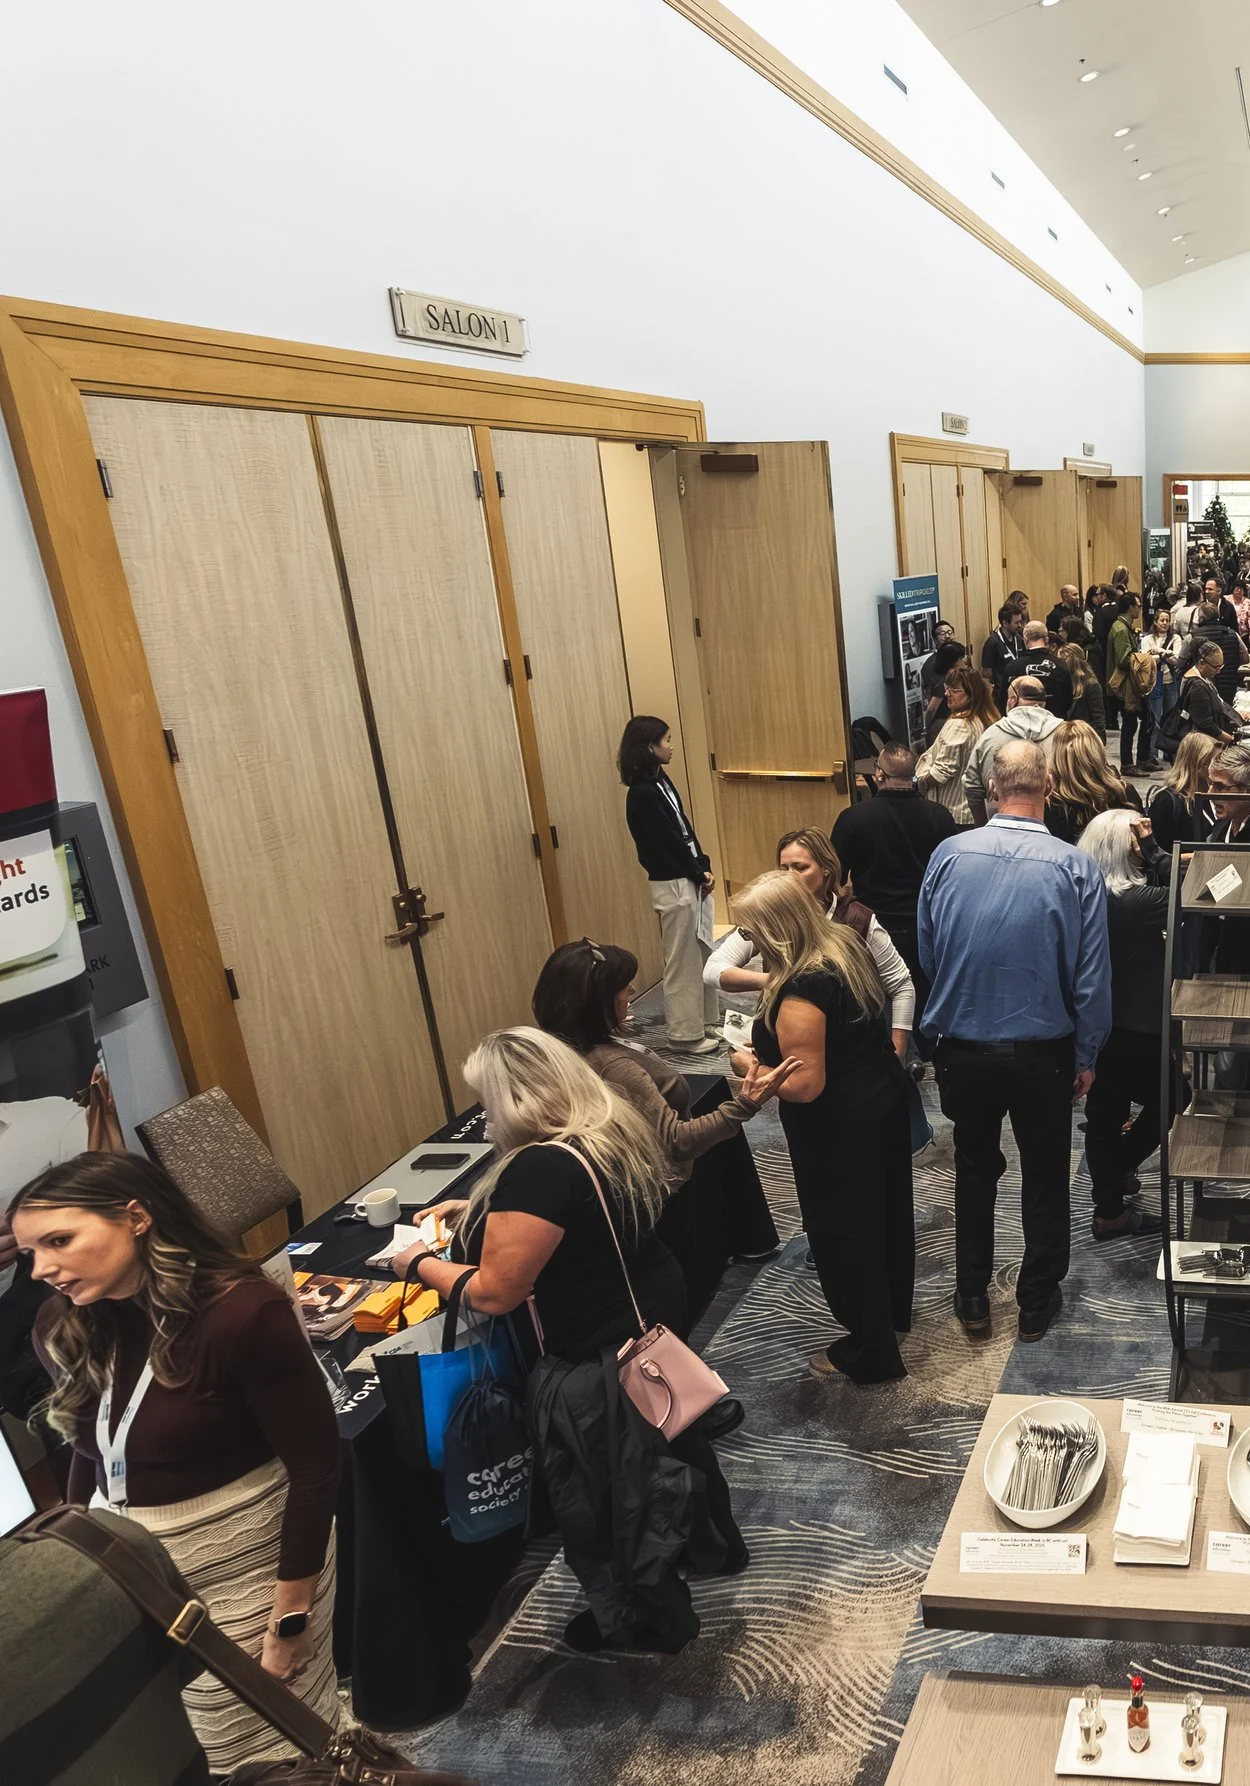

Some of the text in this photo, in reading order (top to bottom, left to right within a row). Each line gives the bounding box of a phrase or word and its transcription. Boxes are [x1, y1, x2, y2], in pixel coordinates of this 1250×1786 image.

[426, 303, 498, 341] SALON
[0, 858, 26, 880] ht
[0, 883, 50, 913] ards
[470, 1487, 521, 1514] society
